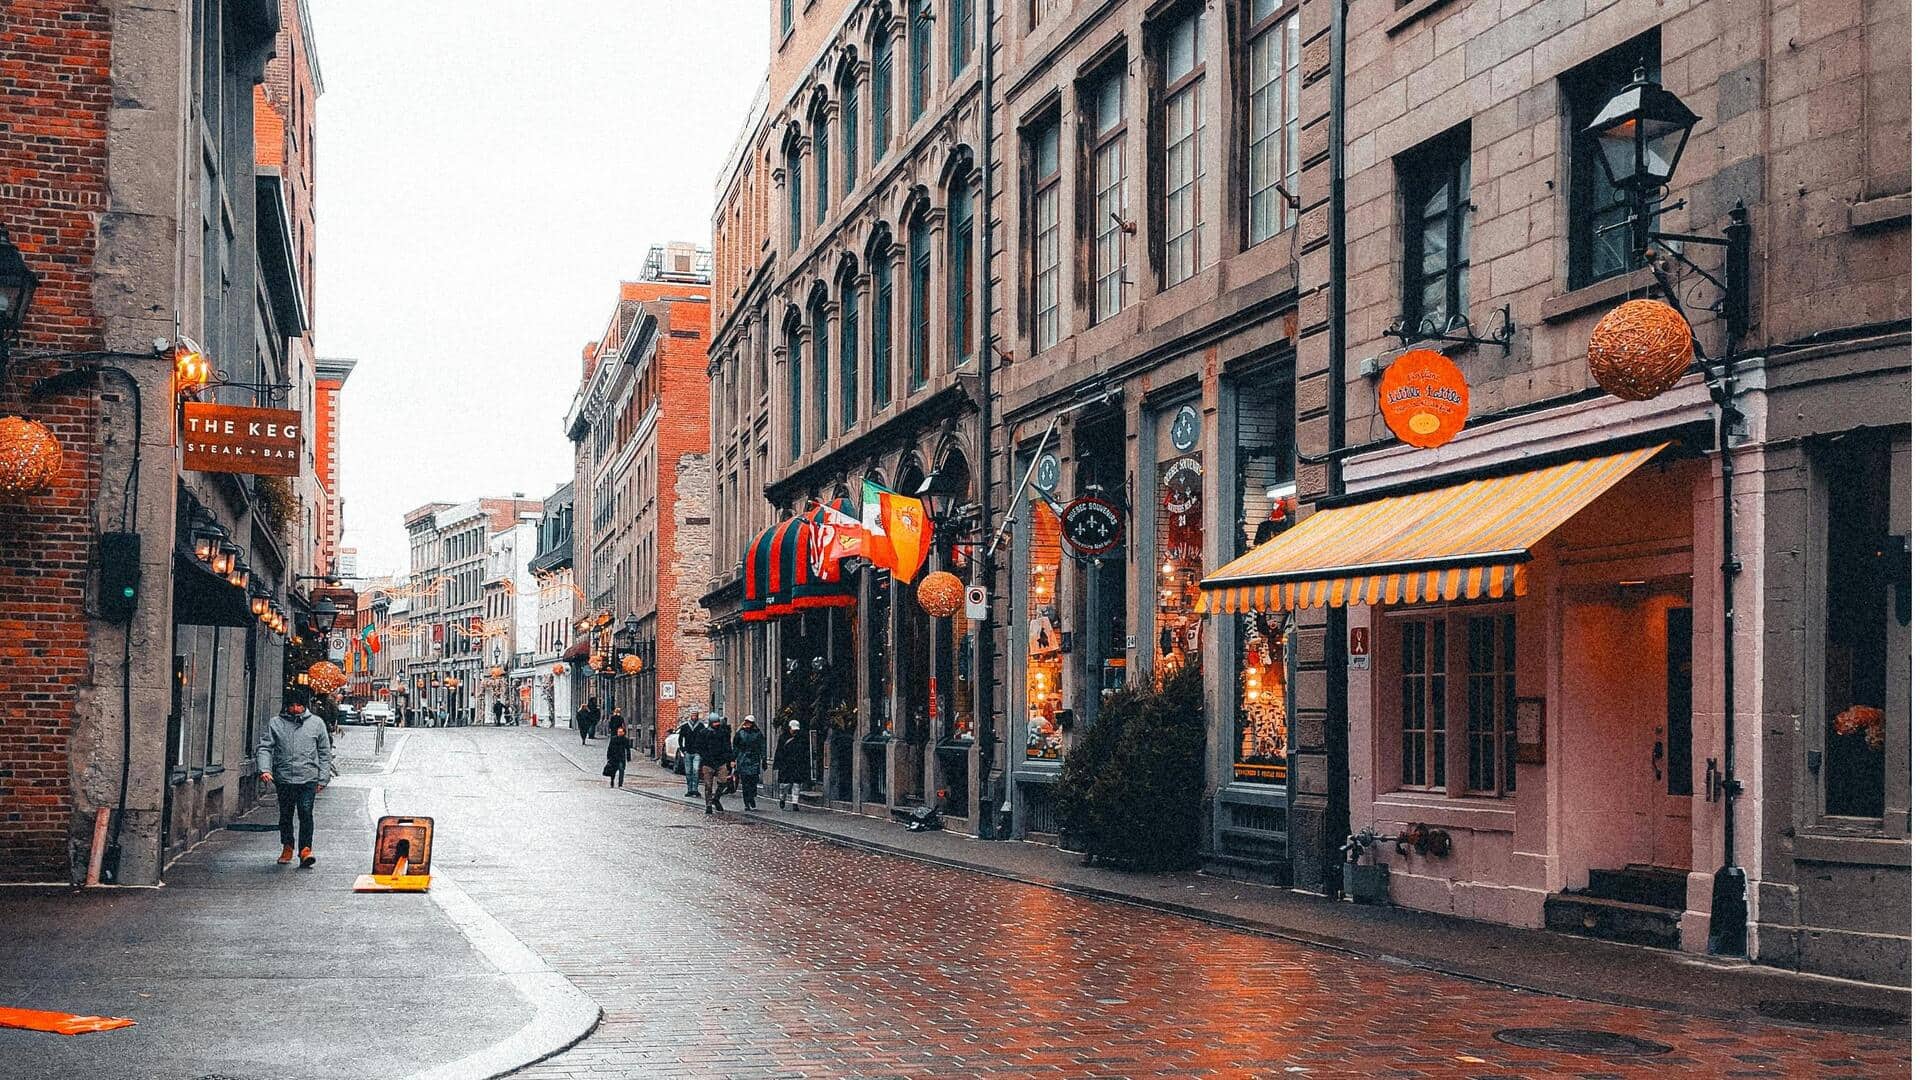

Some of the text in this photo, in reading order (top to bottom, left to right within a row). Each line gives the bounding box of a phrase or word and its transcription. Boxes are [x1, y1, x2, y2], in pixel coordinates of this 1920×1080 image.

[189, 418, 296, 438] THE KEG
[188, 443, 242, 455] STEAK
[264, 449, 295, 459] BAR
[1089, 502, 1118, 525] SOUVENIRS
